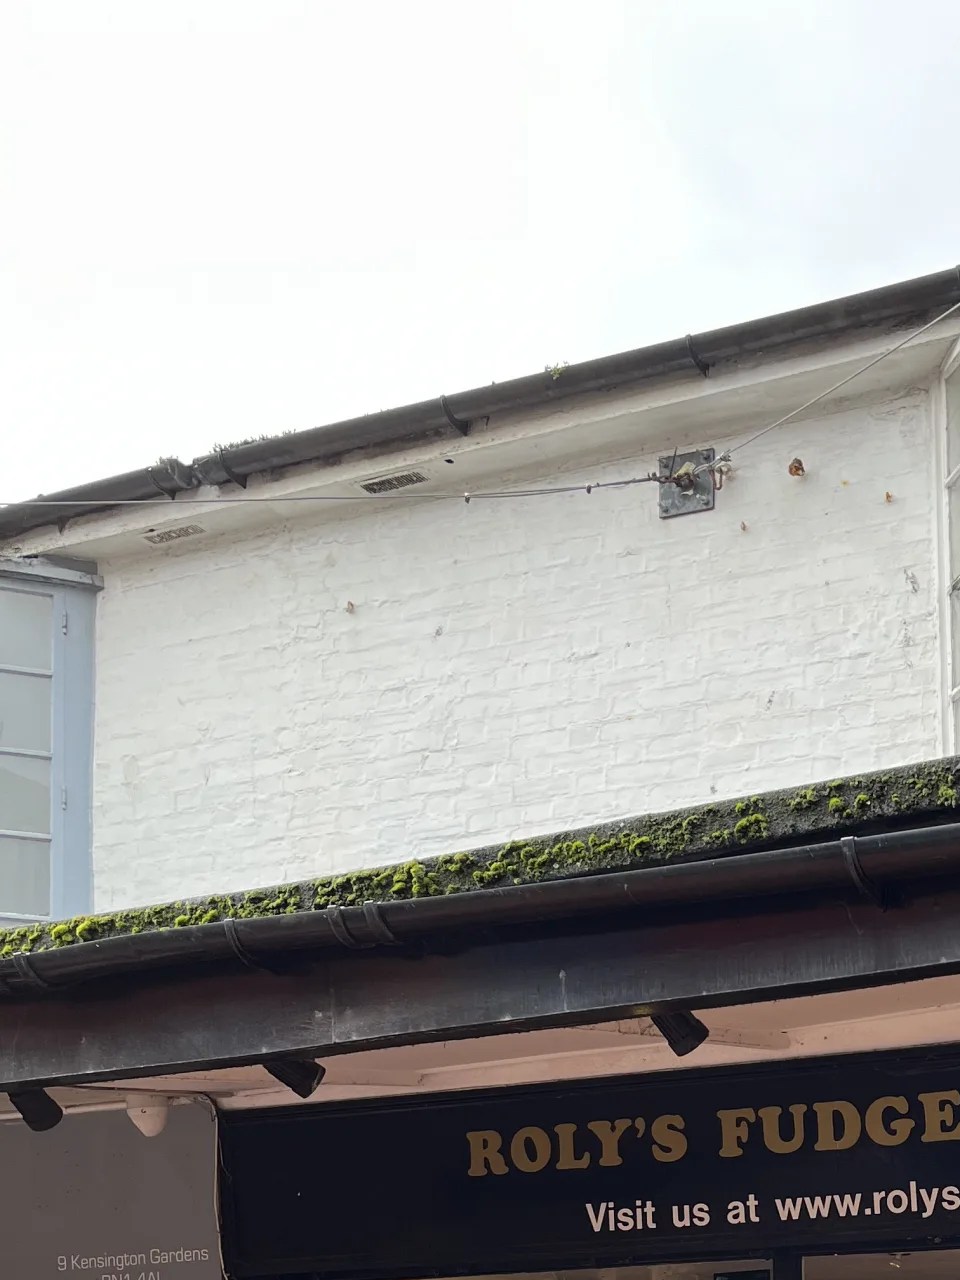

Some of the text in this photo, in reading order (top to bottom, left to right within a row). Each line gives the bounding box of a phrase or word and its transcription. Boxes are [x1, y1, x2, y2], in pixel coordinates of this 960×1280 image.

[466, 1113, 688, 1177] ROLY'S
[585, 1199, 657, 1233] Visit
[672, 1200, 710, 1227] us
[727, 1193, 760, 1224] at
[57, 1247, 209, 1271] 9 Kensington Gardens
